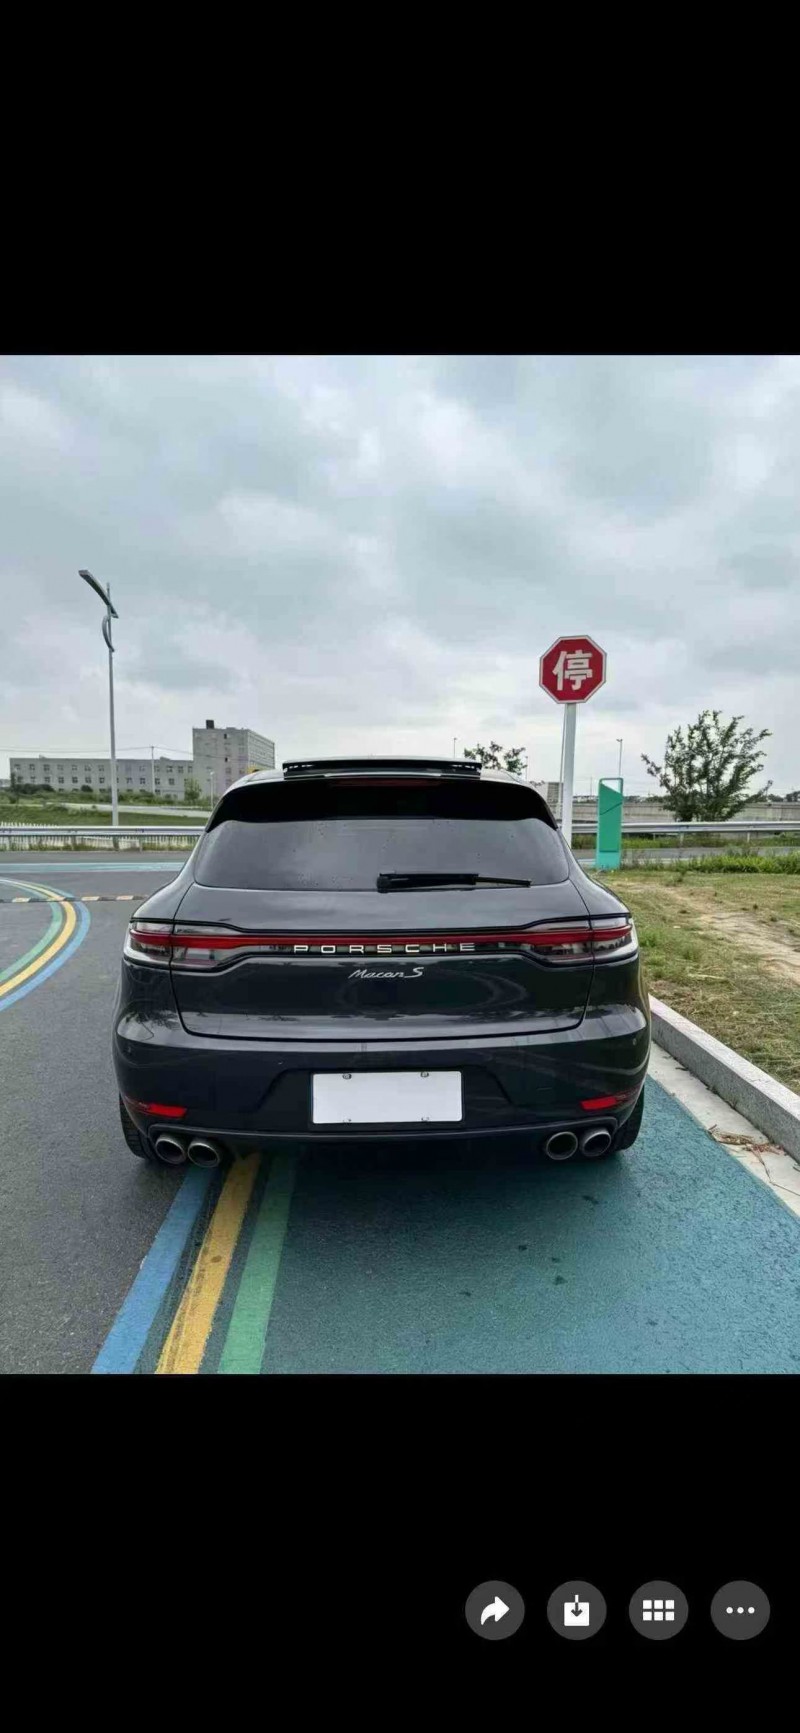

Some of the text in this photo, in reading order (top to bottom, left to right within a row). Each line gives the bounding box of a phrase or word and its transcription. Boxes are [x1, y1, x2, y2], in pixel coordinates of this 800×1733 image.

[552, 649, 593, 691] 停
[294, 942, 475, 954] PORSCHE
[348, 967, 424, 979] Macan S
